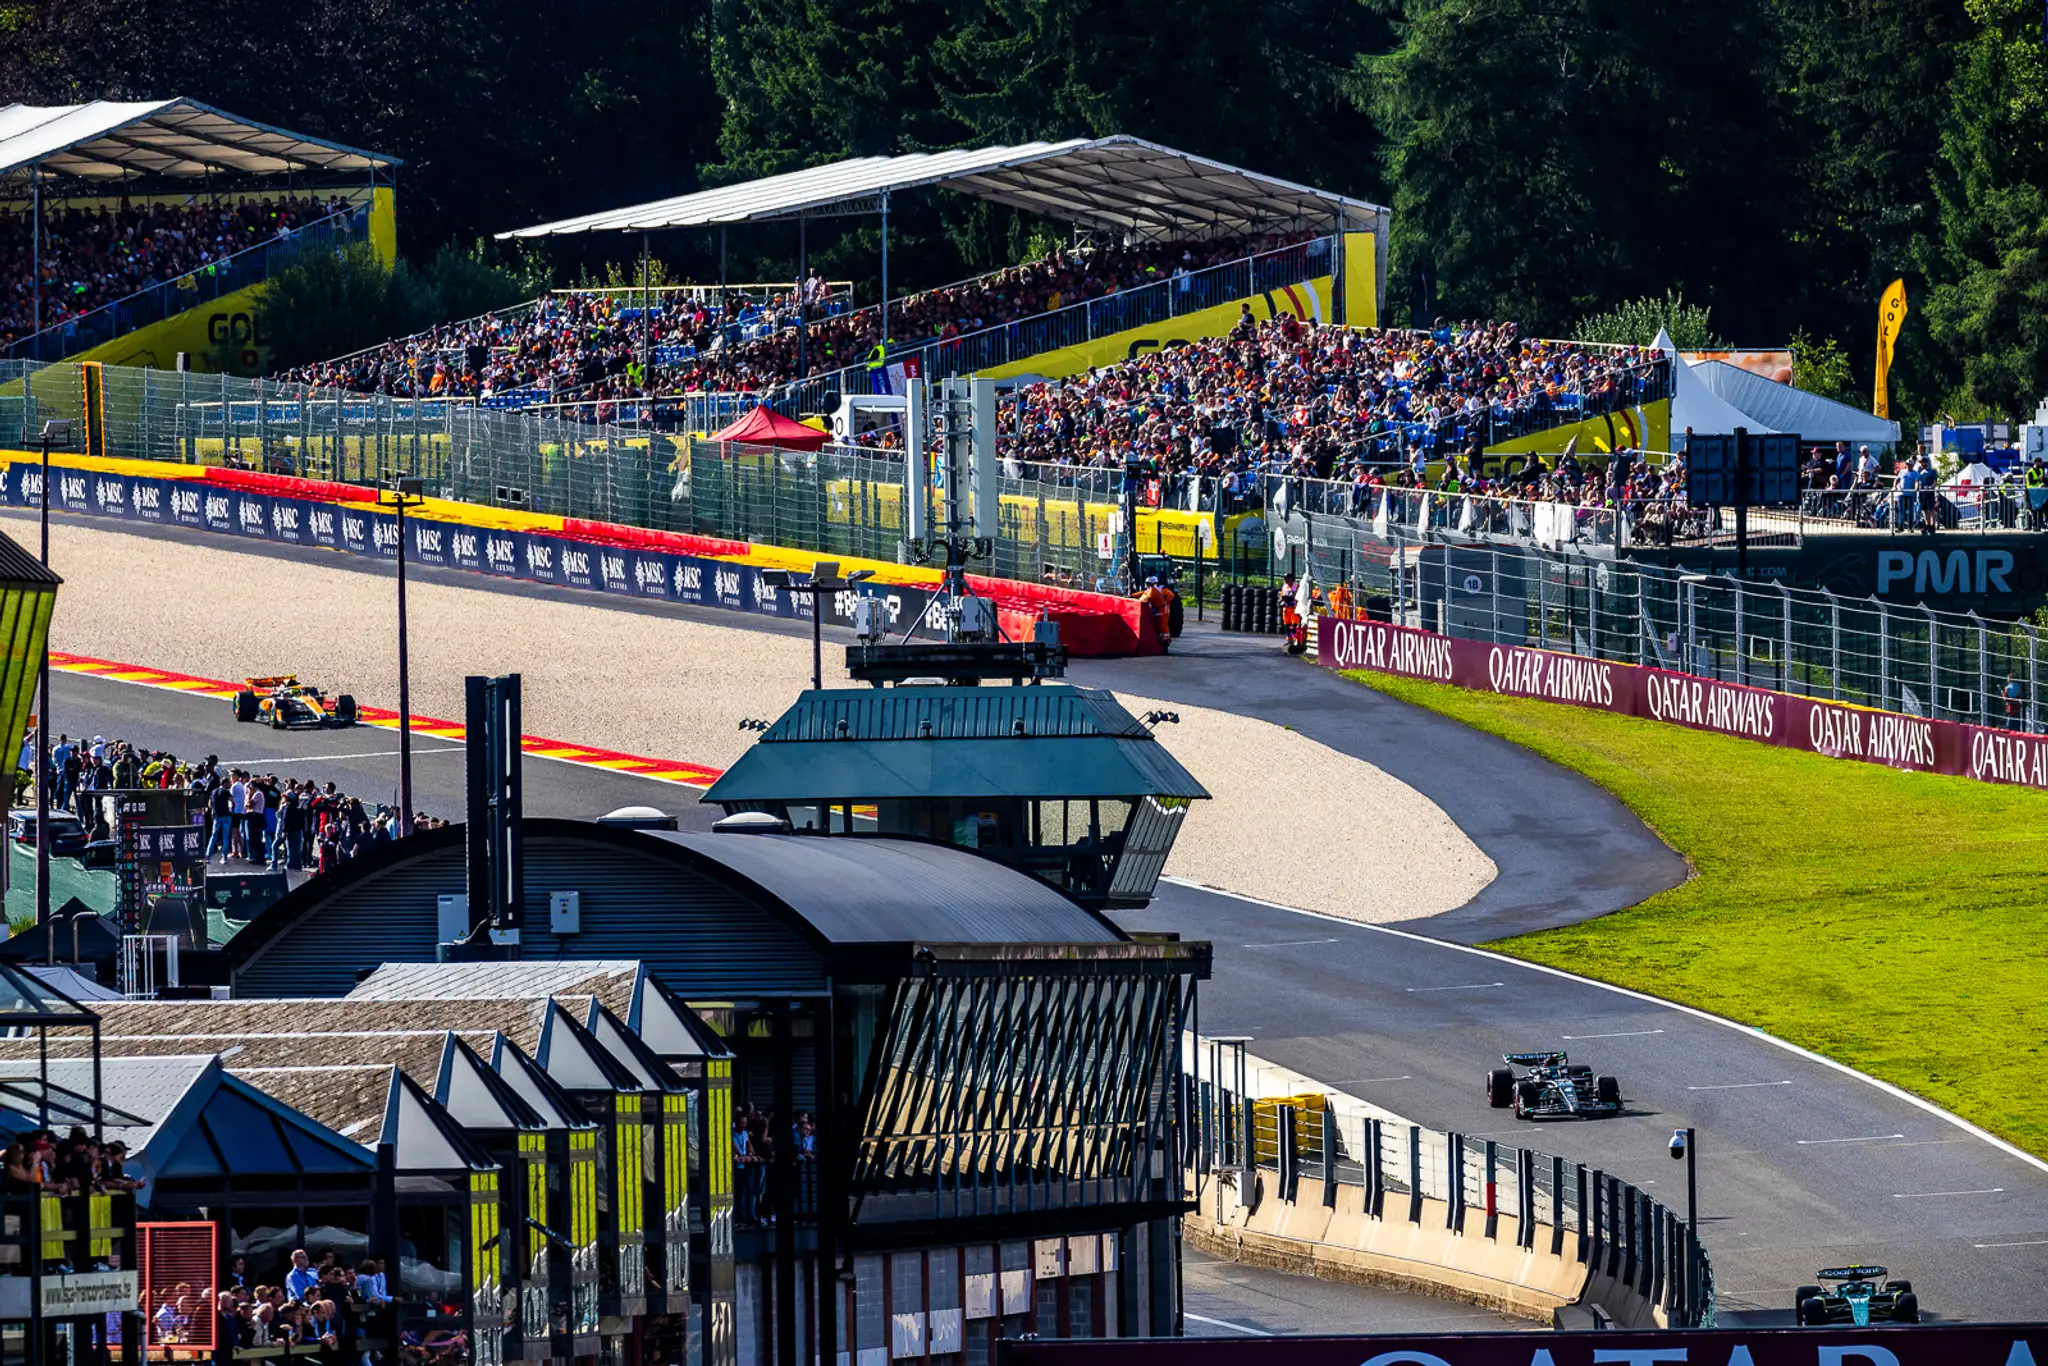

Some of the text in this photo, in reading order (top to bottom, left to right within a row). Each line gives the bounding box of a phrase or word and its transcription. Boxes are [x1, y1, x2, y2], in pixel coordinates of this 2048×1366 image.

[30, 473, 50, 493] MS
[68, 477, 86, 499] MSC
[105, 482, 124, 504] MSC
[142, 487, 160, 508] MSC
[181, 491, 199, 513] MSC
[212, 497, 229, 518] MSC
[245, 502, 263, 525] MSC
[281, 507, 299, 529] MSC
[317, 511, 334, 534] MSC
[347, 517, 364, 540] MSC
[383, 523, 406, 545] MS
[422, 529, 442, 551] MSC
[460, 534, 477, 556] MSC
[495, 540, 514, 563] MSC
[533, 545, 552, 568] MSC
[568, 552, 590, 575] MSC
[608, 557, 626, 580] MSC
[644, 562, 665, 584] MSC
[1877, 549, 2014, 594] PMR
[684, 567, 701, 589] MSC
[723, 572, 739, 595] MSC
[1334, 621, 1452, 680] QATAR AIRWAYS
[1489, 647, 1613, 706] QATAR AIRWAYS
[1648, 674, 1774, 737] QATAR AIRWAYS
[1809, 704, 1934, 766] QATAR AIRWAYS
[1972, 731, 2048, 786] QATAR AI
